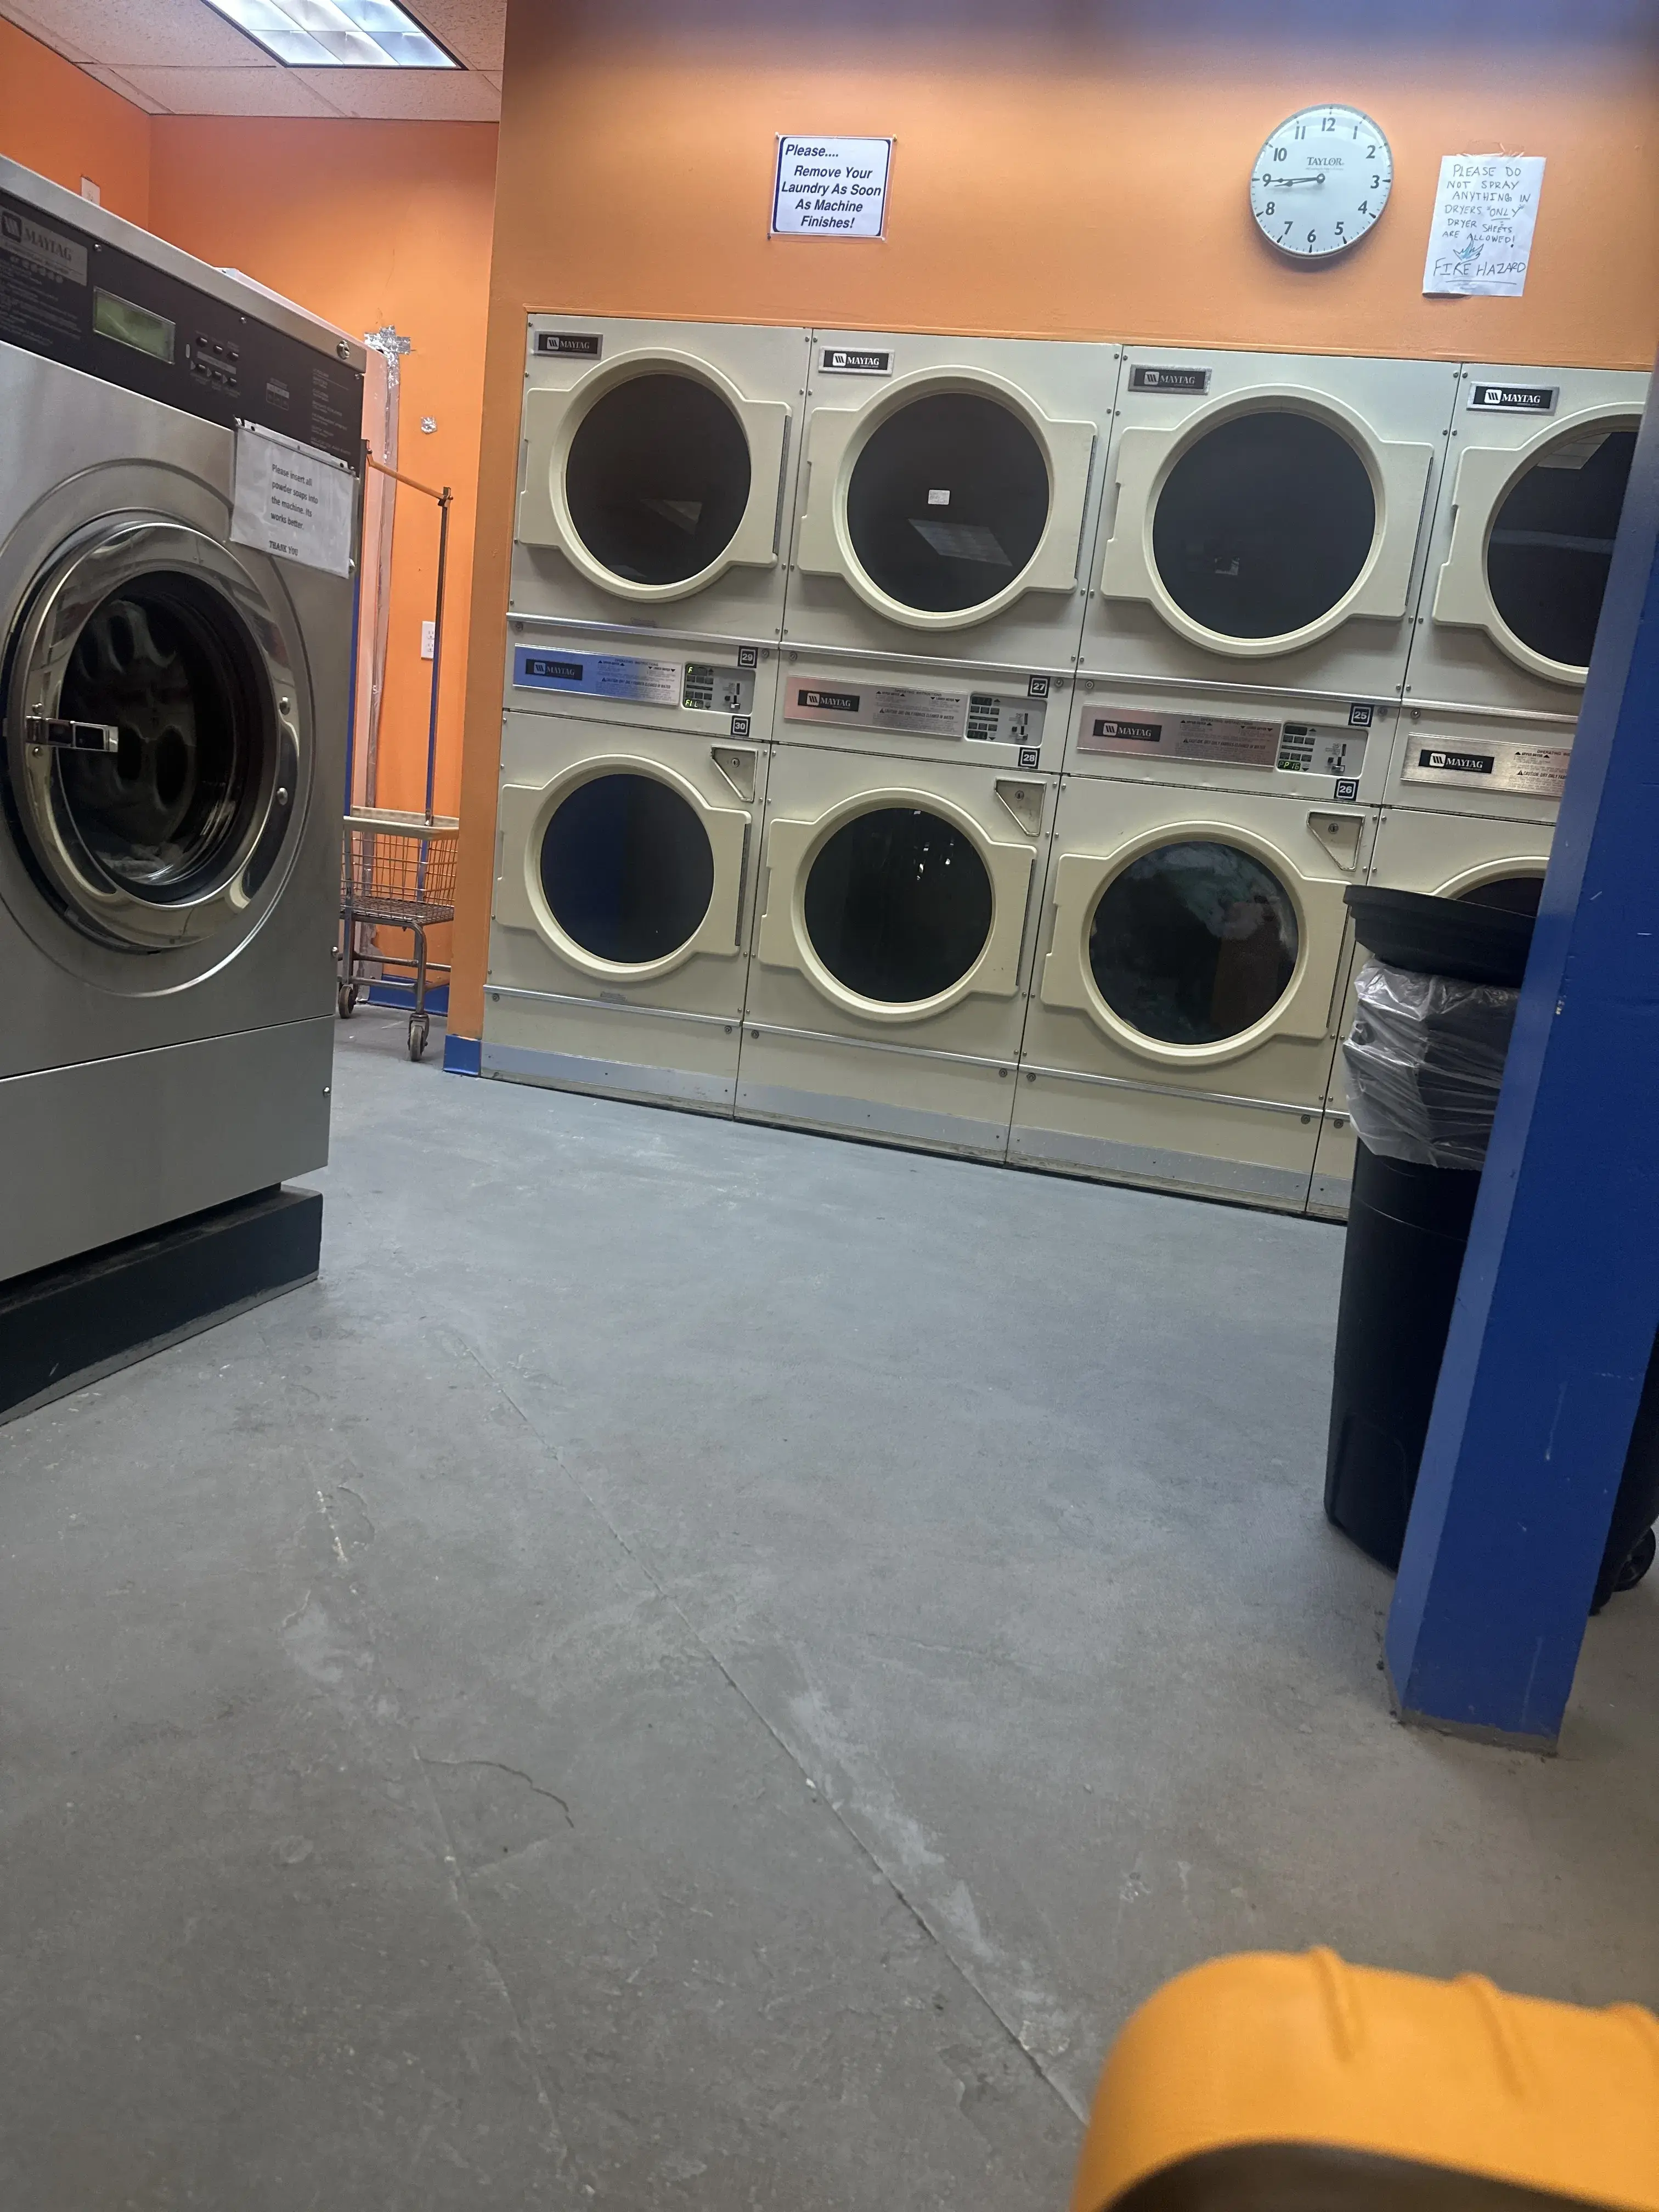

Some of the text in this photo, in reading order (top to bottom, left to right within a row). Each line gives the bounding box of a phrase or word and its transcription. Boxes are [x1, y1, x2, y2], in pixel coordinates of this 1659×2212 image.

[1321, 117, 1336, 132] 12
[1295, 126, 1306, 139] 11
[1353, 126, 1358, 139] 1
[785, 144, 839, 157] Please....
[1273, 148, 1287, 161] 10
[1365, 145, 1376, 159] 2
[1307, 157, 1342, 165] TAYLOR
[794, 165, 873, 179] Remove Your
[1453, 164, 1521, 177] PLEASE DO
[1262, 173, 1272, 187] 9
[1370, 175, 1380, 189] 3
[1447, 180, 1520, 190] NOT SPRAY
[781, 181, 881, 196] Laundry As Soon
[1452, 191, 1531, 202] ANYTHING IN
[795, 199, 863, 212] As Machine
[1266, 201, 1275, 215] 8
[1358, 200, 1368, 214] 4
[1444, 204, 1482, 215] DRYERS
[800, 215, 855, 228] Finishes!
[1284, 221, 1293, 235] 7
[1448, 218, 1513, 233] DRYER SHEETS
[1334, 222, 1344, 235] 5
[1307, 229, 1316, 243] 6
[1467, 233, 1515, 248] ALLOWED!
[25, 228, 72, 261] MAYTAG
[1433, 257, 1526, 276] FIRE HAZARD
[560, 341, 590, 349] MAYTAG
[847, 357, 879, 365] MAYTAG
[1160, 375, 1195, 384] MAYTAG
[1502, 393, 1541, 403] MAYTAG
[272, 464, 289, 477] Please
[290, 472, 305, 484] insert
[272, 481, 318, 504] powder soaps into
[272, 496, 280, 506] the
[270, 512, 287, 524] works
[269, 540, 298, 556] THANK YOU
[546, 666, 575, 675] MAYTAG
[1033, 682, 1045, 691] 27
[820, 697, 851, 707] MAYTAG
[1354, 711, 1367, 719] 25
[1118, 727, 1152, 737] MAYTAG
[1446, 758, 1483, 768] MAYTAG
[1339, 785, 1352, 793] 26
